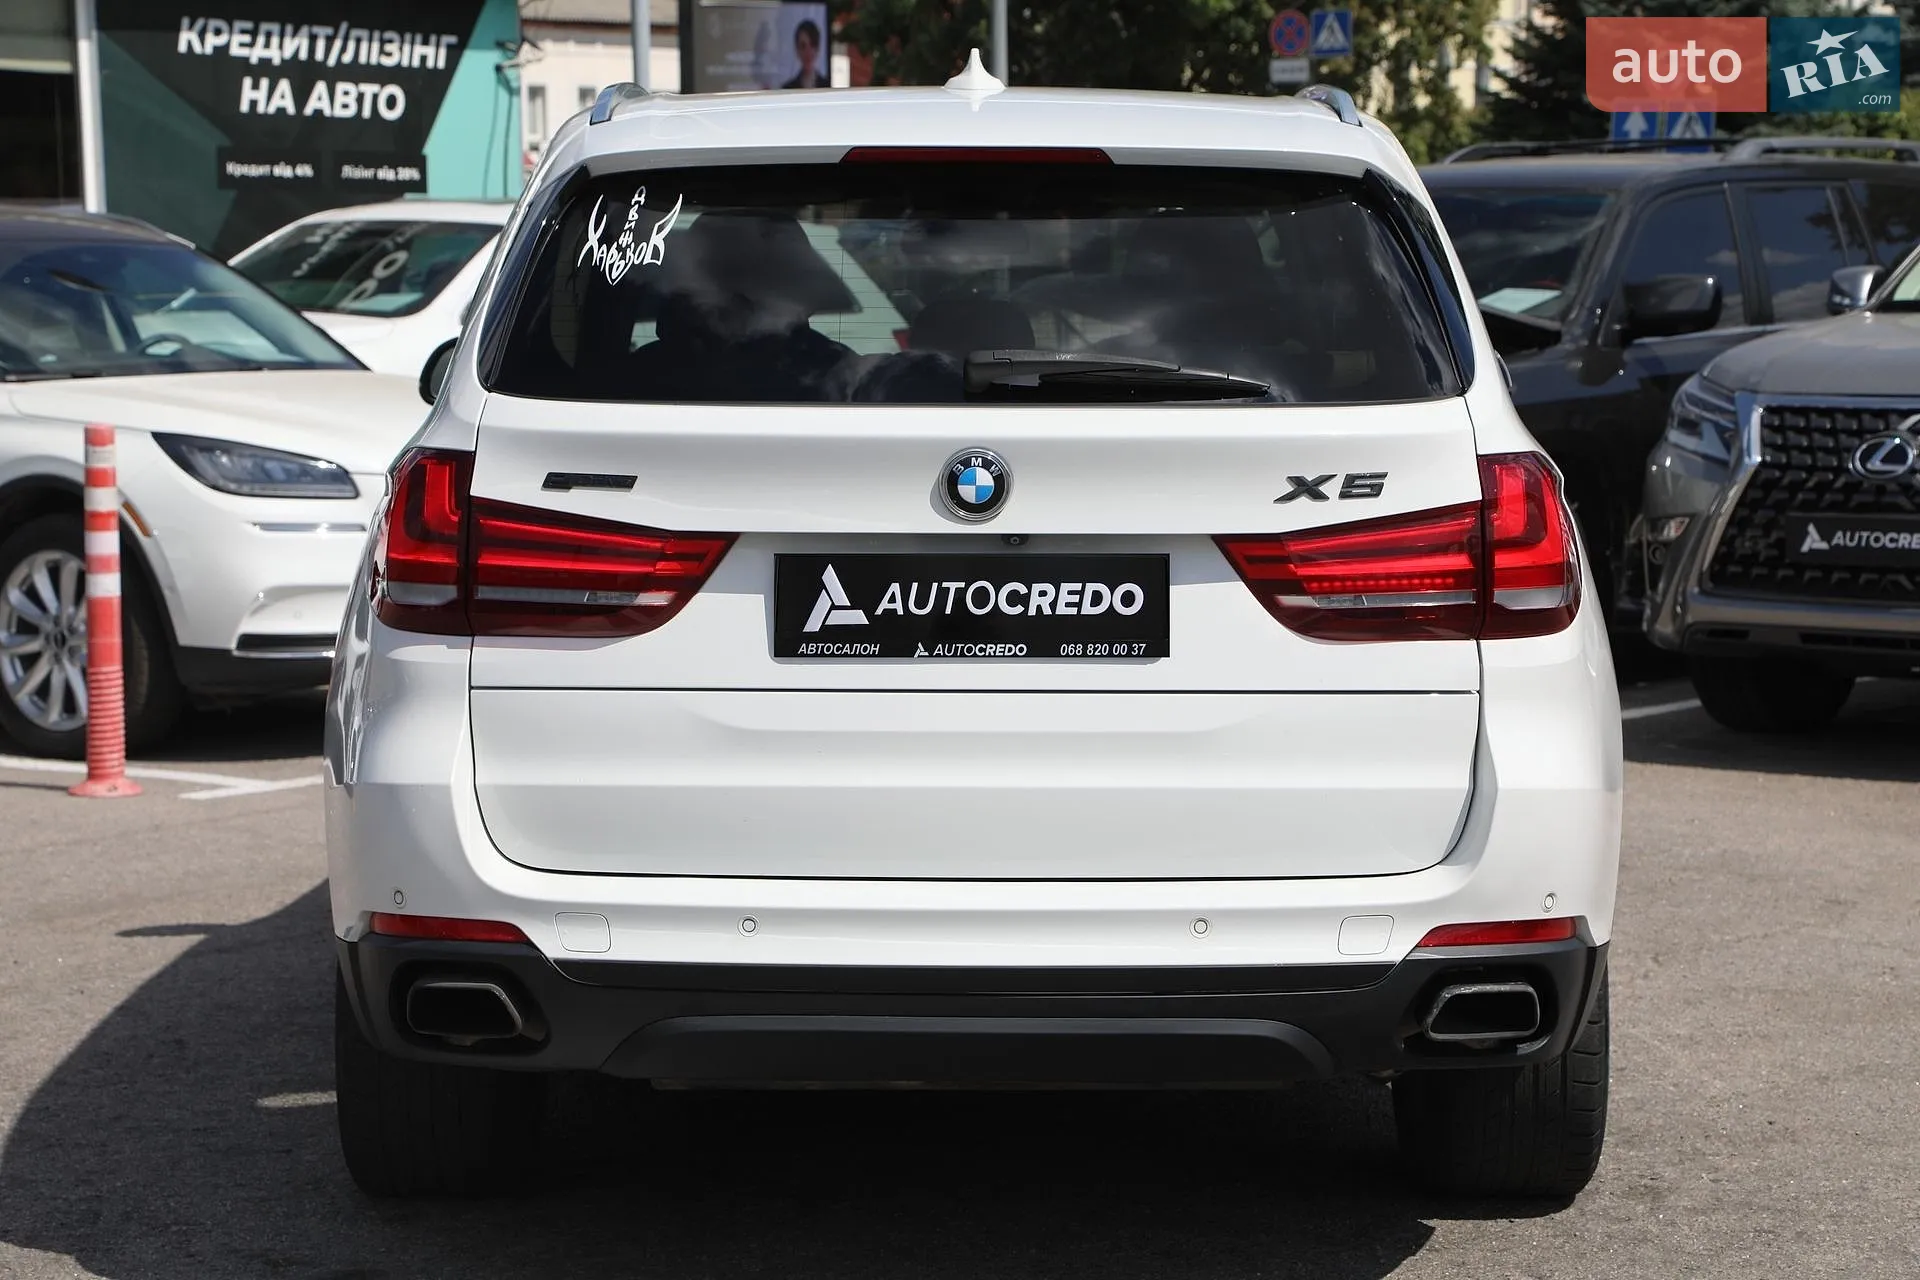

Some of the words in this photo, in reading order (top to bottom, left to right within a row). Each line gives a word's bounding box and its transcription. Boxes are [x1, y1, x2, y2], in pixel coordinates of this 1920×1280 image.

[177, 16, 459, 70] КРЕДИТ/ЛІЗІНГ
[239, 76, 297, 116] НА
[303, 79, 407, 121] АВТО
[952, 457, 1002, 477] BMW
[1272, 471, 1389, 504] X5
[875, 580, 1145, 616] AUTOCREDO
[798, 643, 880, 656] АВТОСАЛОН
[933, 643, 1027, 657] AUTOCREDO
[1060, 643, 1083, 656] 068
[1086, 643, 1110, 656] 820
[1112, 643, 1130, 656] 00
[1131, 643, 1147, 656] 37
